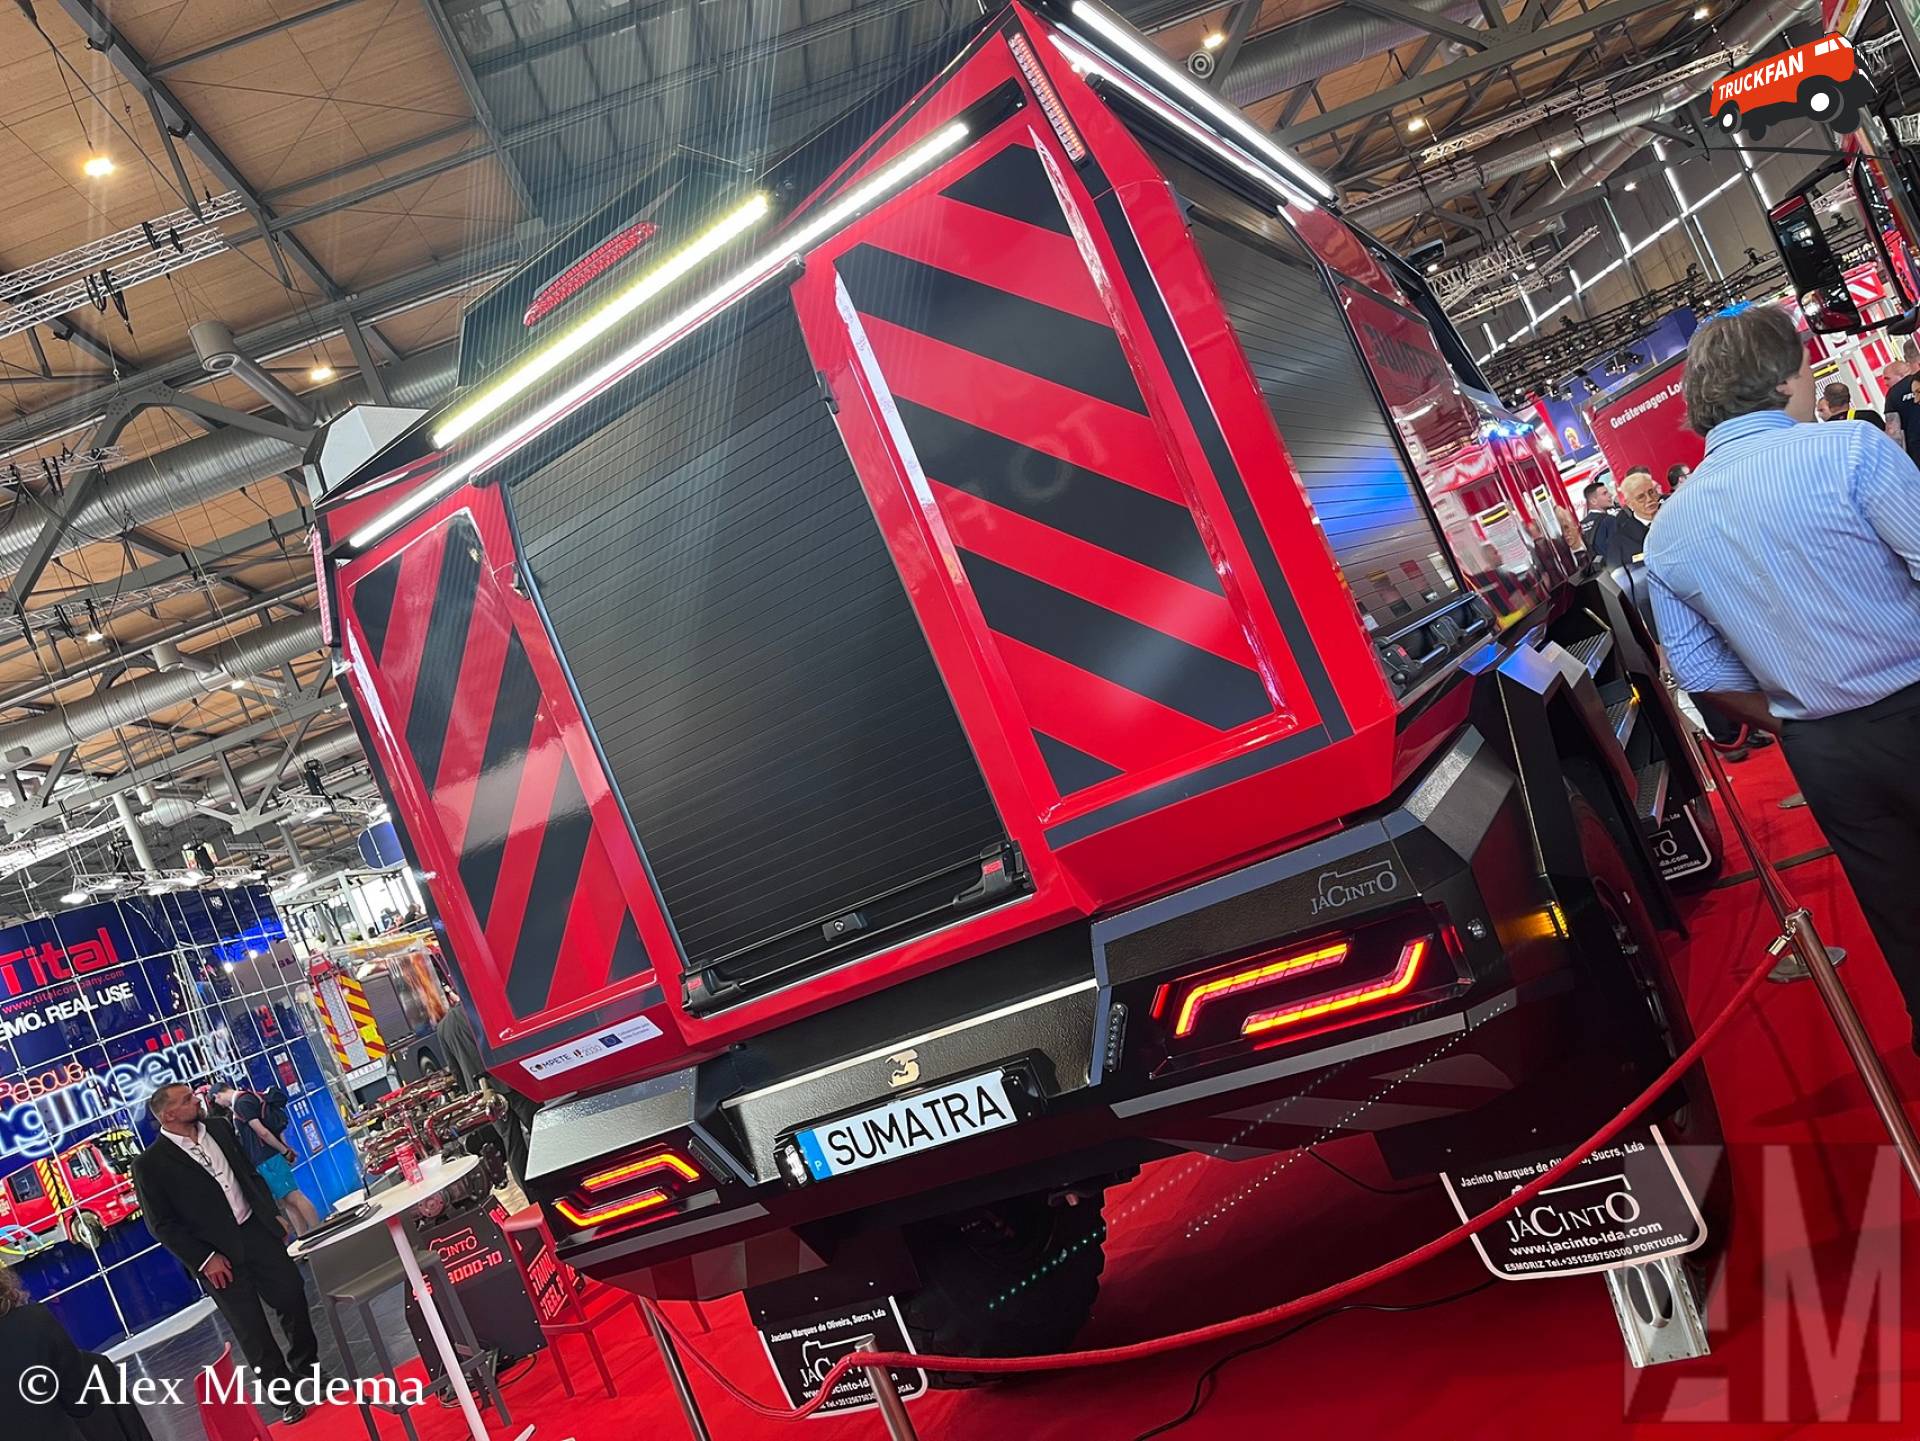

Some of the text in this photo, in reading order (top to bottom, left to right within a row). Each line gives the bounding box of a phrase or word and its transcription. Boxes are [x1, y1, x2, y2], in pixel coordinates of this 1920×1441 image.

[1610, 390, 1669, 429] Gerätewagen
[1310, 870, 1398, 915] JACINTO
[0, 927, 118, 996] Tital
[44, 995, 99, 1024] REAL
[96, 982, 134, 1006] USE
[827, 1086, 1007, 1166] SUMATRA
[1461, 1175, 1494, 1188] Jacinto
[1494, 1165, 1535, 1182] Marques
[1535, 1161, 1549, 1173] de
[1591, 1147, 1625, 1163] Sucrs,
[1623, 1141, 1645, 1154] Lda
[1506, 1191, 1640, 1243] JACINTO
[1504, 1259, 1545, 1272] ESMORIZ
[1633, 1233, 1688, 1254] PORTUGAL
[1509, 1222, 1663, 1256] www.jacinto-lda.com
[771, 1332, 792, 1343] Jacinto
[791, 1326, 818, 1337] Marques
[818, 1323, 827, 1332] de
[872, 1308, 886, 1318] Lda
